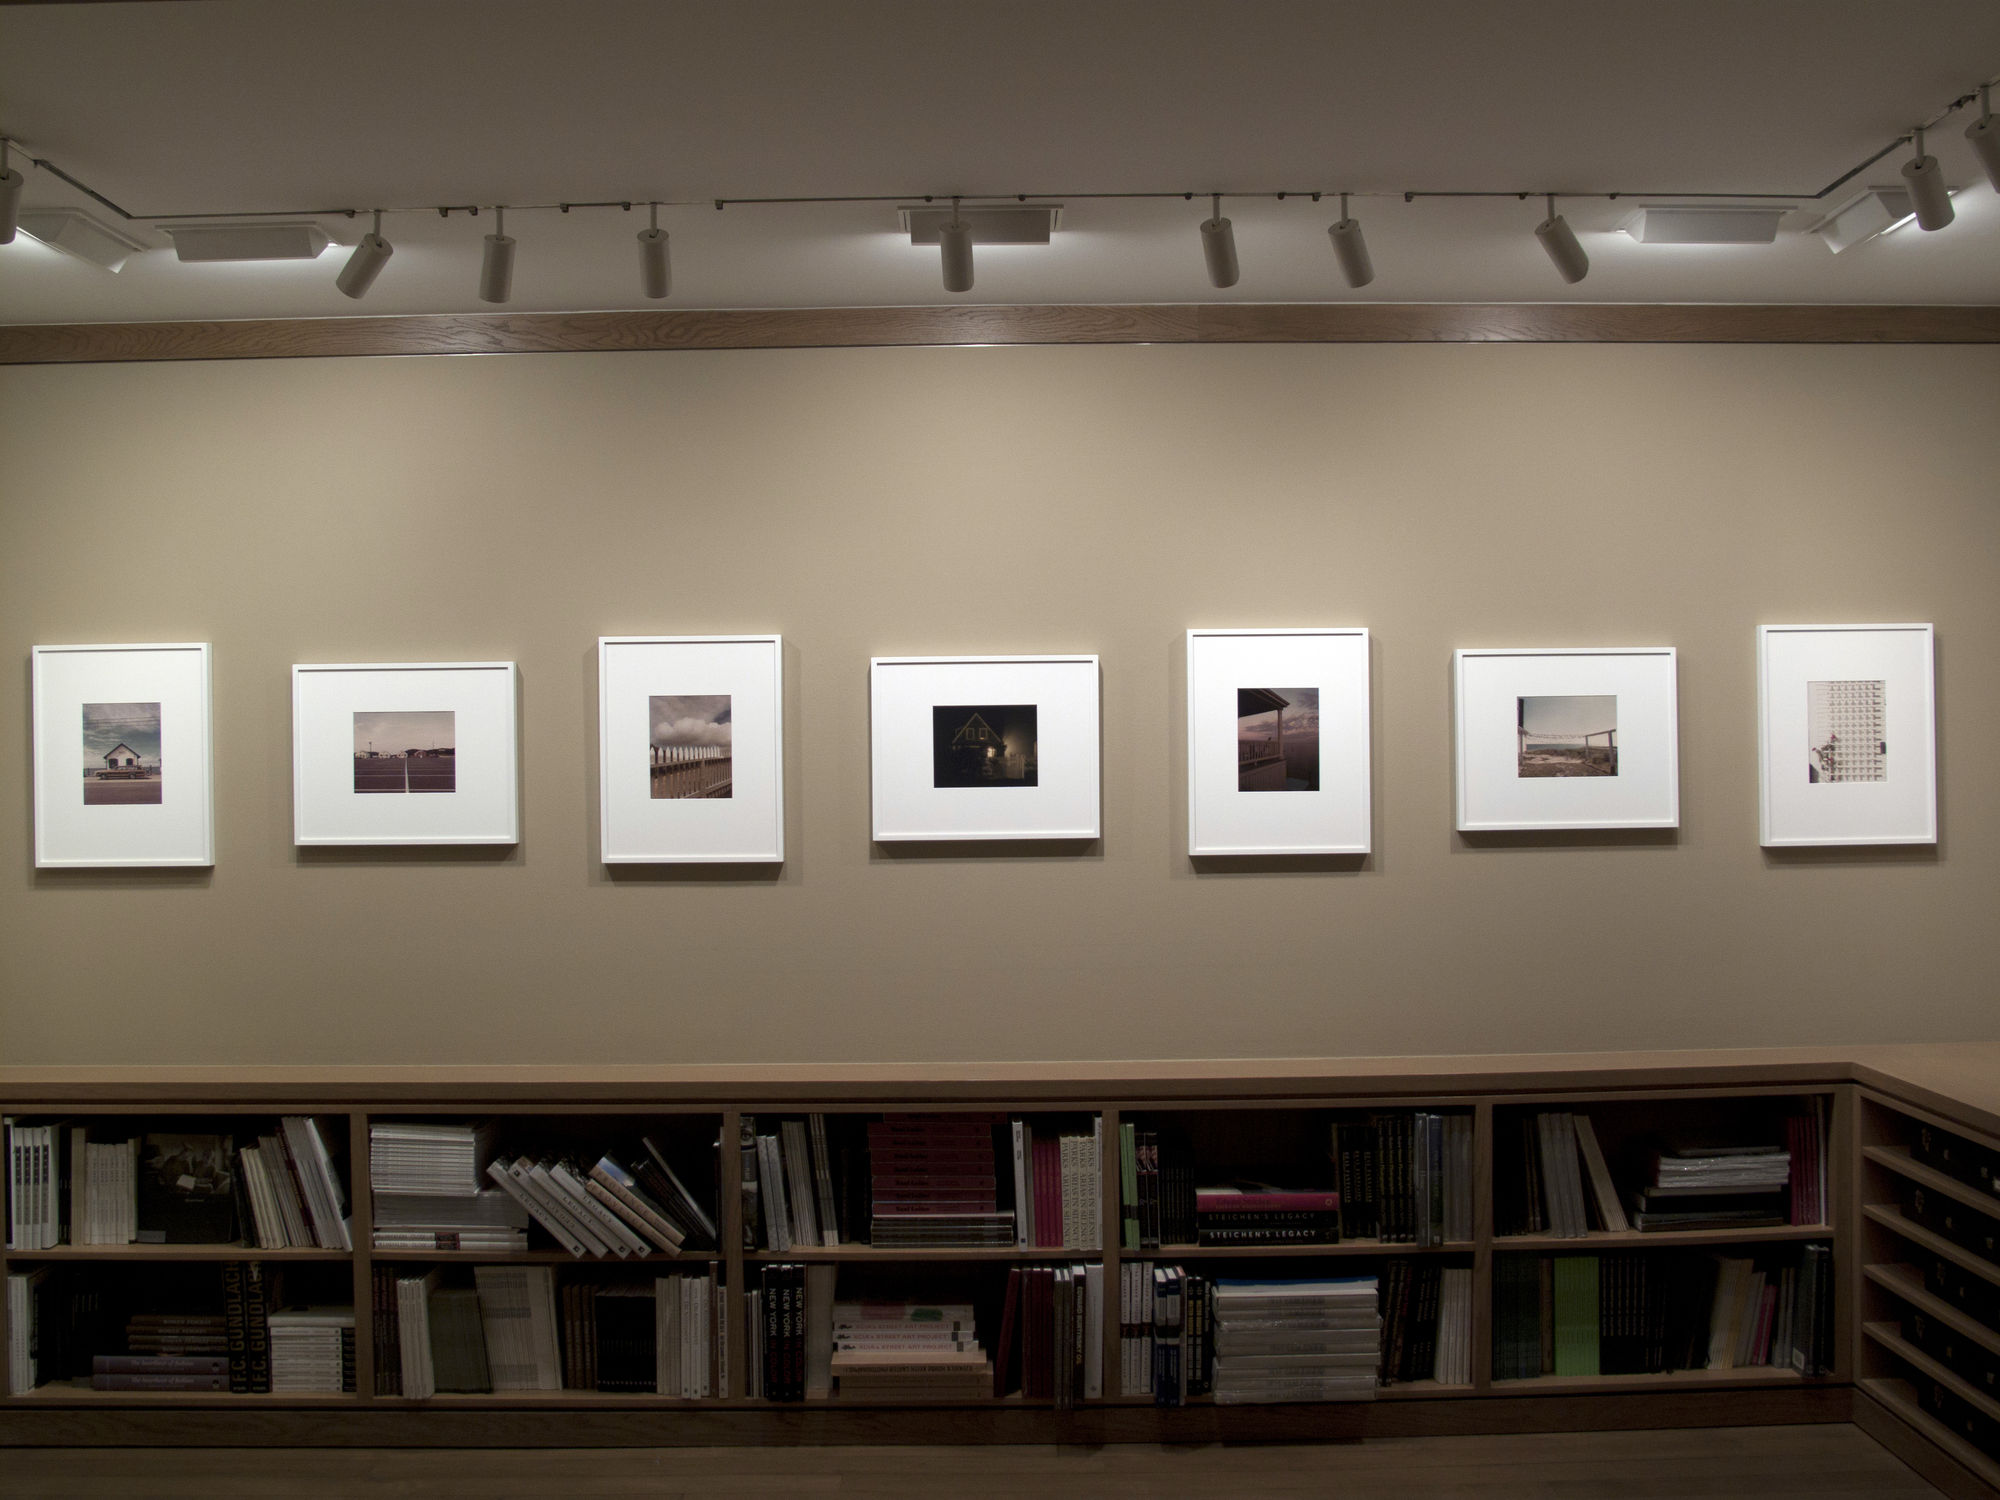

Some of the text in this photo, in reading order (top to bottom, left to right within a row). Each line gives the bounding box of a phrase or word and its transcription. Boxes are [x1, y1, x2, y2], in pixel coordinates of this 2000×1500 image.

[1208, 1212, 1315, 1221] STEICHEN'S LEGACY
[1209, 1230, 1317, 1240] STEICHEN'S LEGACY
[769, 1287, 777, 1310] NEW
[783, 1288, 791, 1310] NEW
[795, 1286, 803, 1309] NEW
[224, 1260, 248, 1383] F.C. GUNDLACH
[769, 1311, 777, 1337] YORK
[783, 1312, 791, 1338] YORK
[795, 1310, 803, 1336] YORK
[252, 1356, 268, 1383] F.C.
